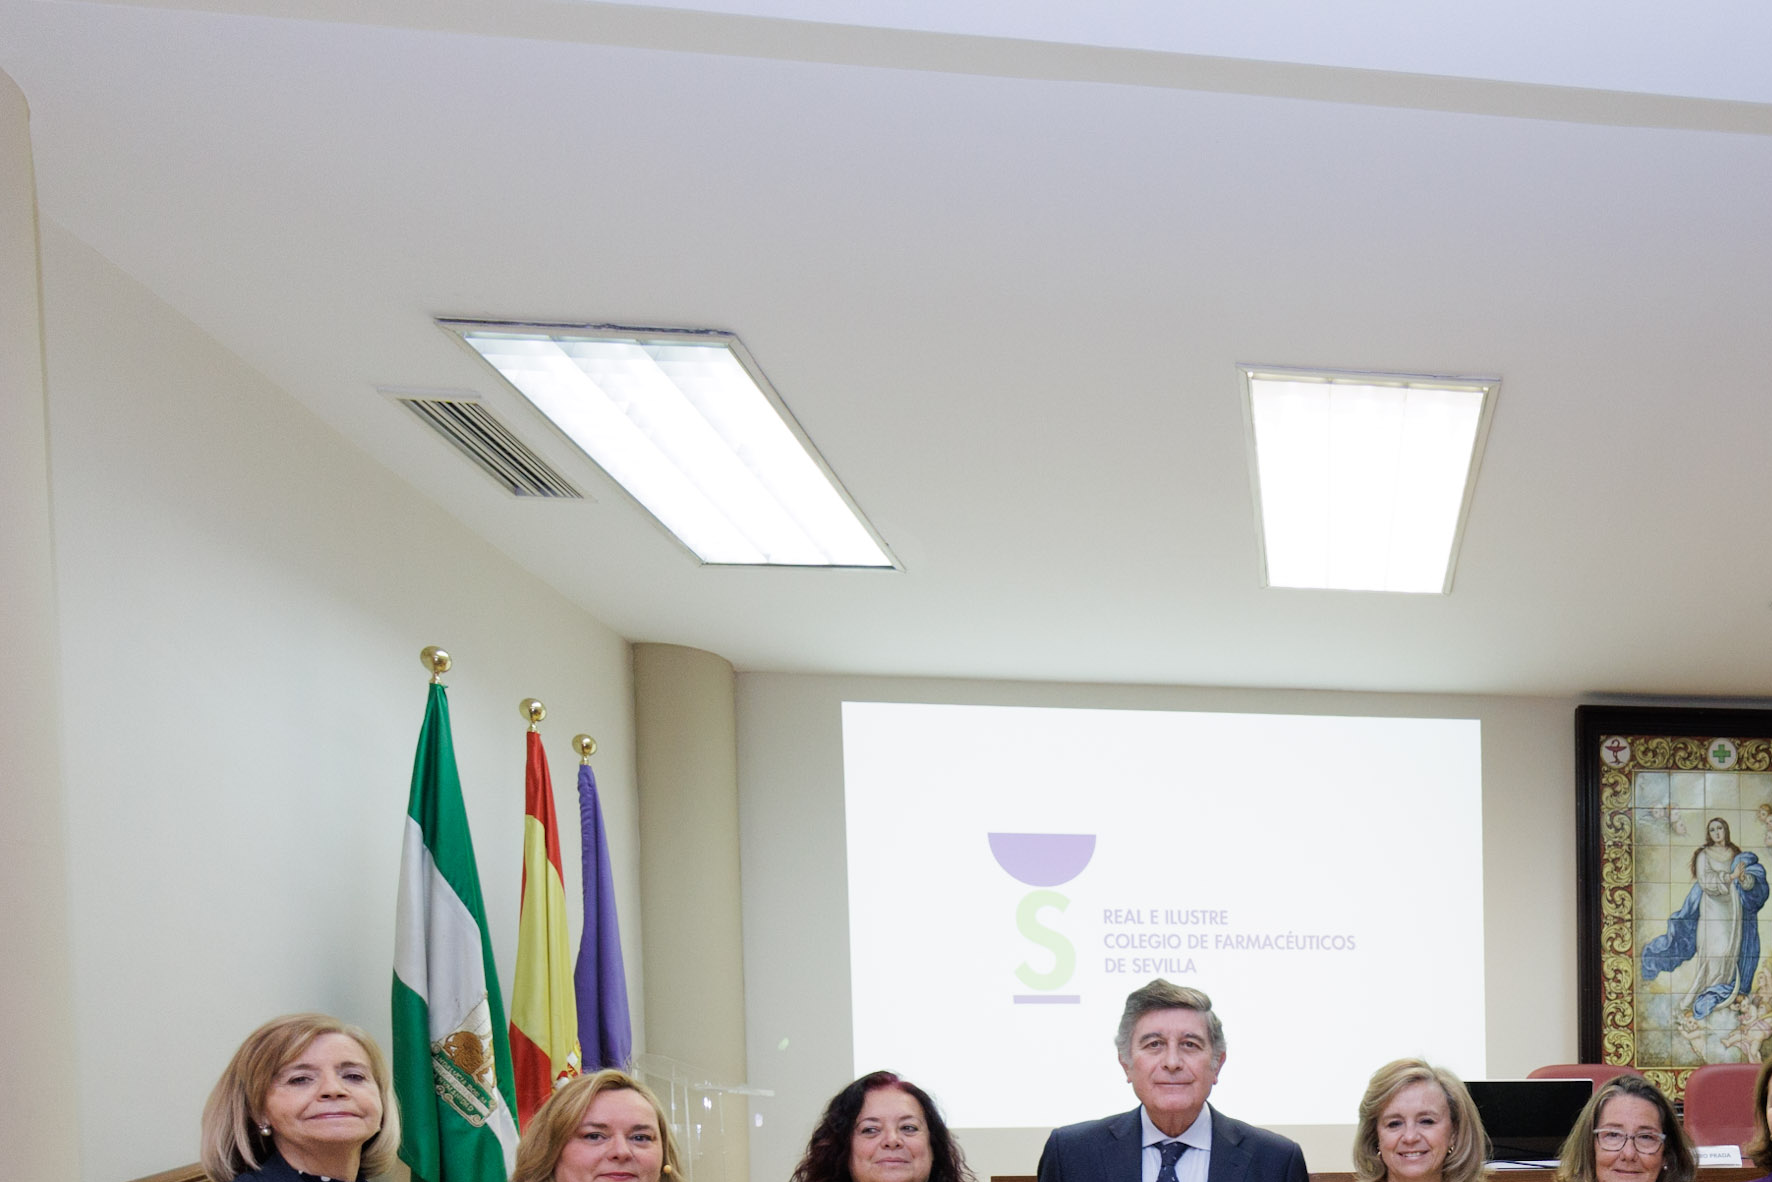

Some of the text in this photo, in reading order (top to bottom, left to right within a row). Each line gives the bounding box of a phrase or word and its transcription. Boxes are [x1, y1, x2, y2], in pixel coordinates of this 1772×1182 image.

[1103, 908, 1229, 926] REAL E ILUSTRE
[1103, 930, 1356, 951] COLEGIO DE FARMACÉUTICOS
[1104, 957, 1197, 974] DE SEVILLA
